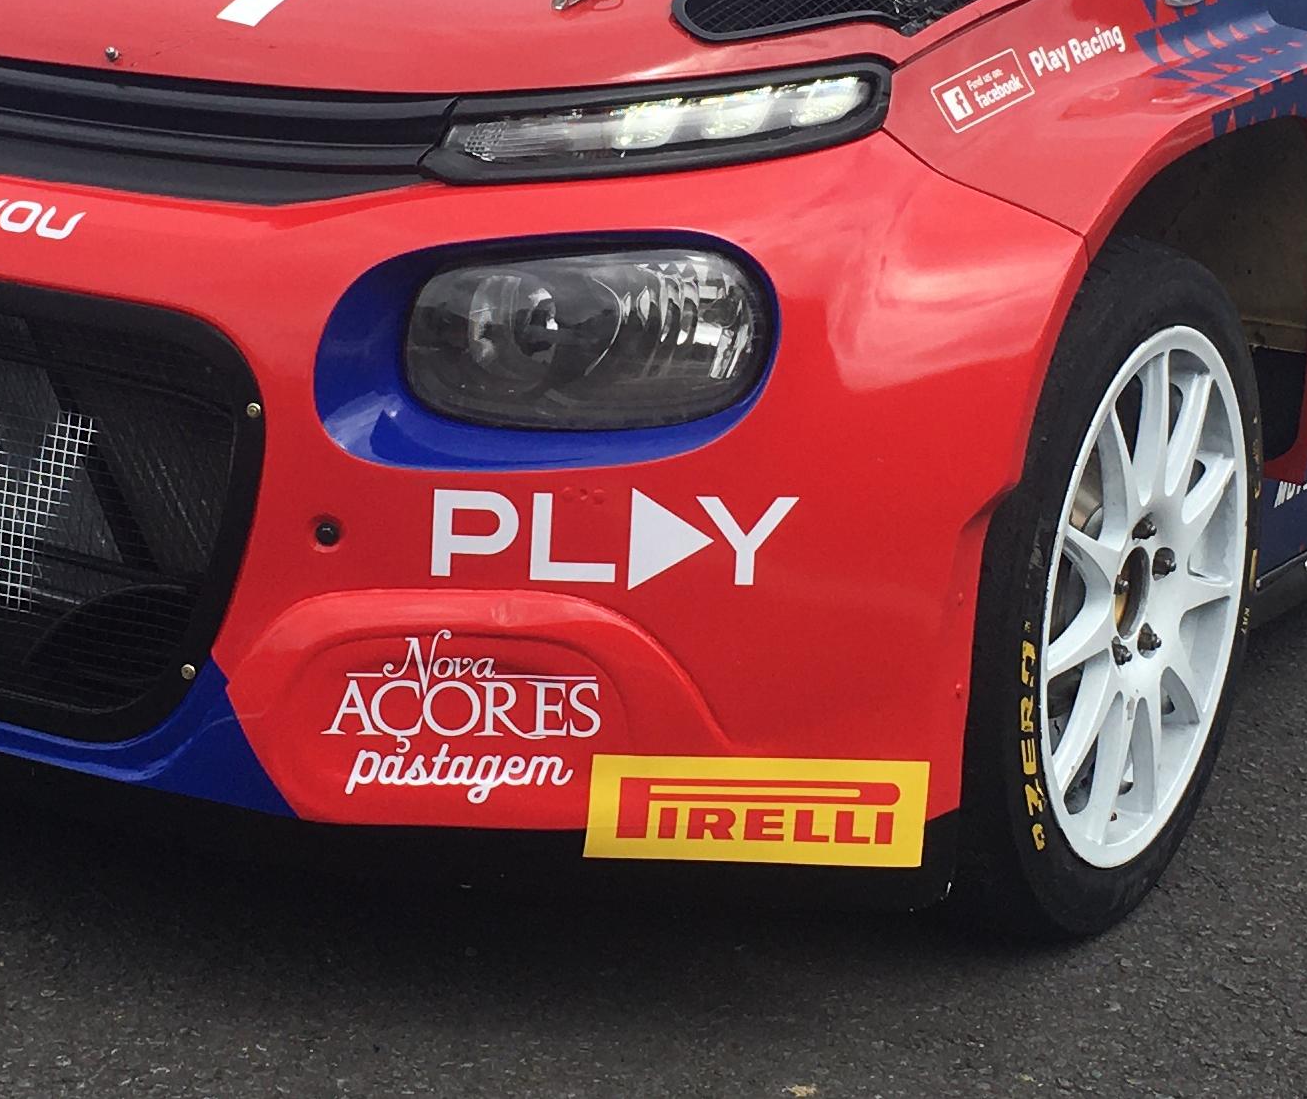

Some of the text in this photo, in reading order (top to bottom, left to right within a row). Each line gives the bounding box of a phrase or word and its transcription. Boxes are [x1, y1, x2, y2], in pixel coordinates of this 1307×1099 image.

[1028, 25, 1126, 77] Play Racing
[974, 73, 1024, 109] facebook
[430, 487, 800, 591] PLAY
[383, 629, 497, 679] Nova
[321, 675, 601, 752] AÇORES
[345, 742, 573, 805] pastagem
[615, 776, 901, 845] PIRELLI
